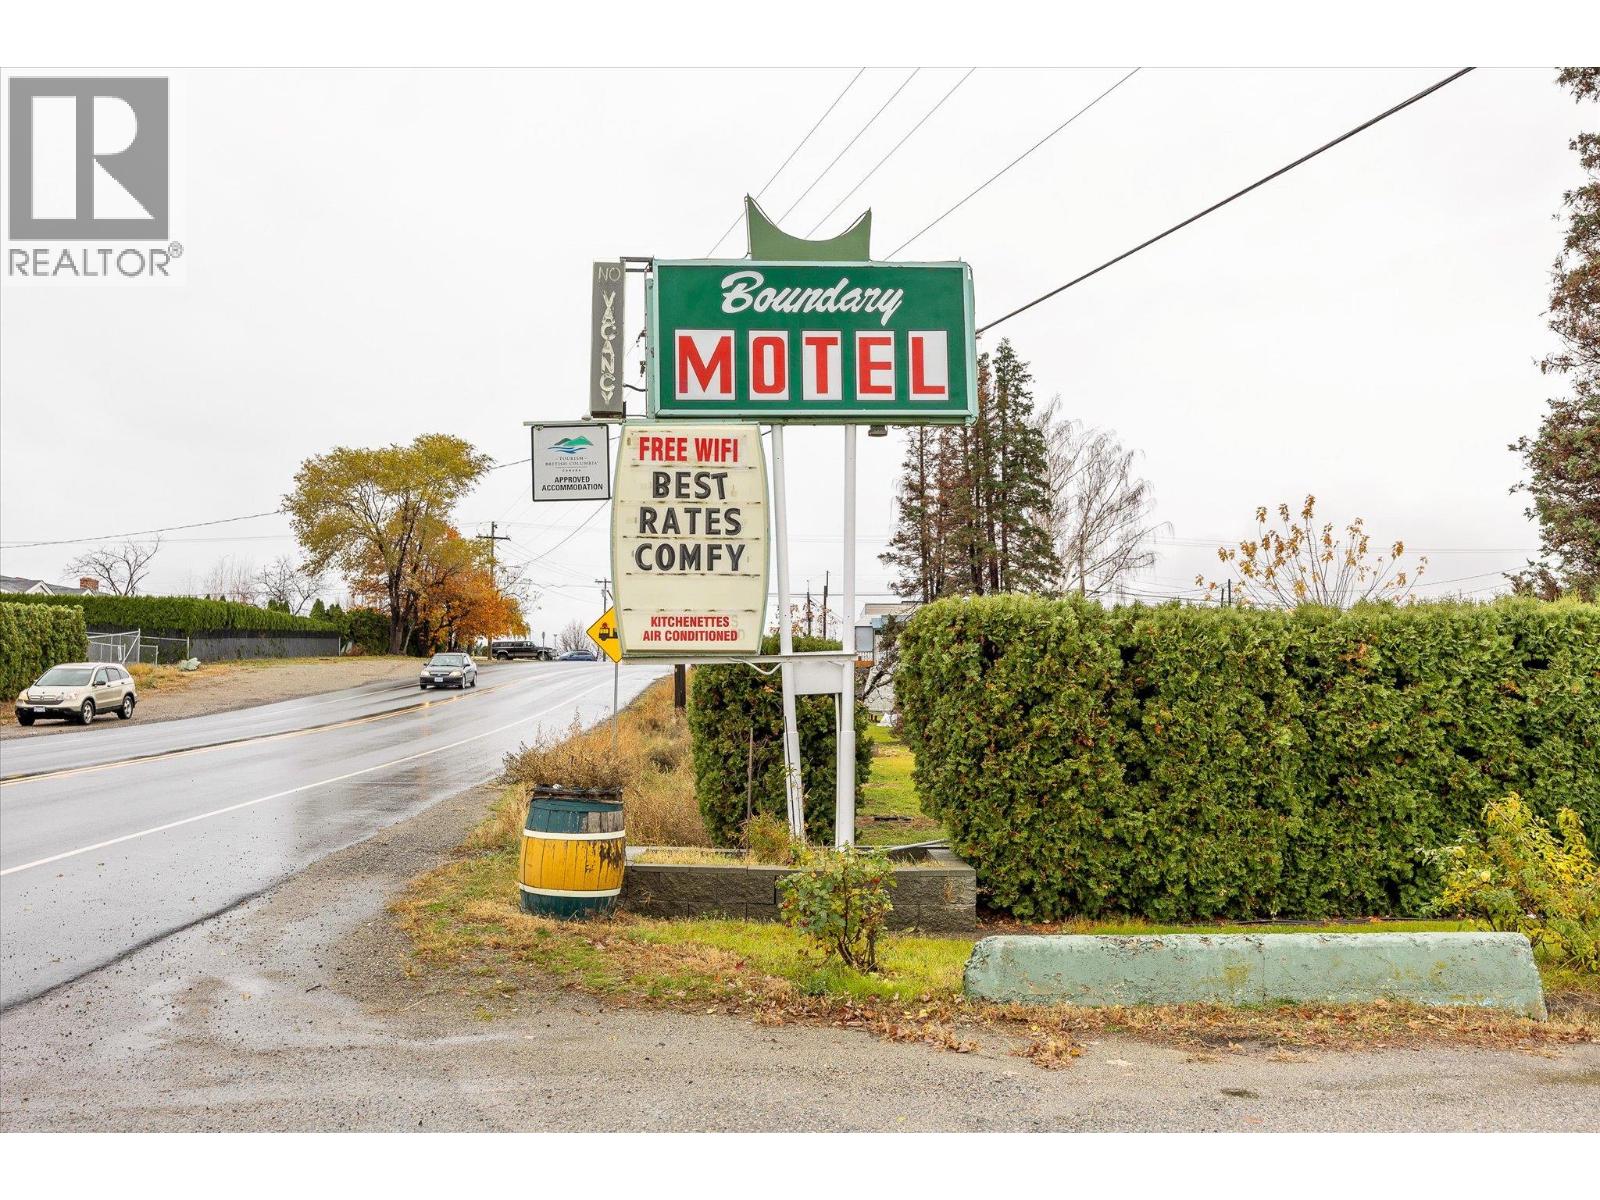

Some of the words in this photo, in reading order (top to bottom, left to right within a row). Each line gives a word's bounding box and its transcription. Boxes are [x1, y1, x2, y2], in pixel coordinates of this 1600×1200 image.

[598, 266, 621, 282] NO
[720, 270, 905, 326] Boundary
[600, 290, 617, 405] VACANCY
[678, 335, 946, 395] MOTEL
[639, 436, 692, 462] FREE
[695, 438, 739, 463] WIFI
[652, 471, 728, 500] BEST
[639, 507, 742, 535] RATES
[635, 543, 746, 572] COMFY
[643, 630, 661, 642] AIR
[664, 629, 738, 642] CONDITIONED
[650, 615, 730, 628] KITCHENETTES
